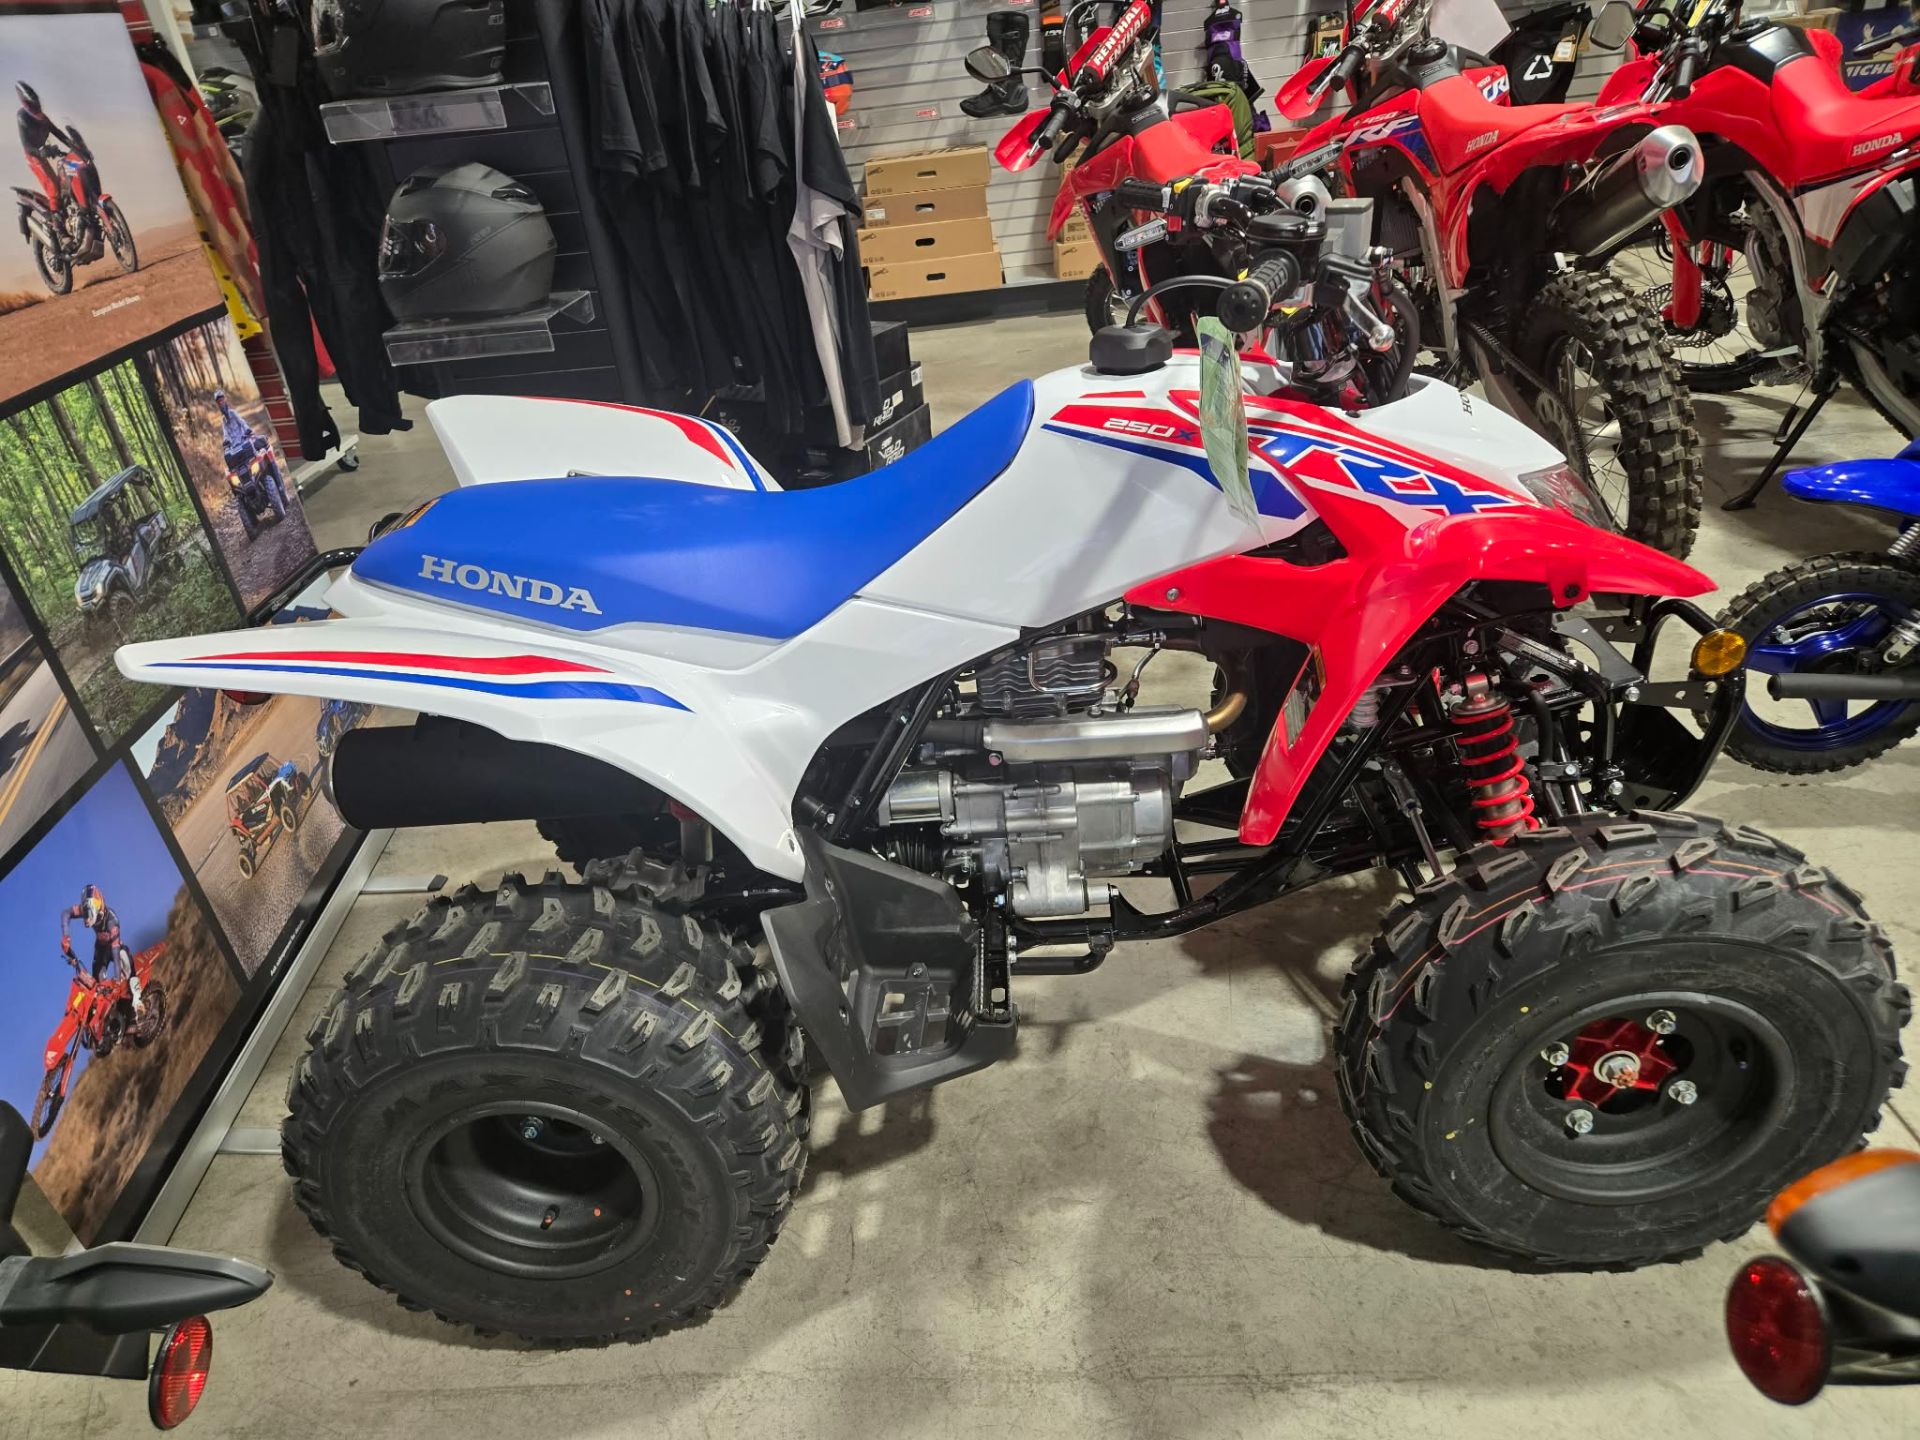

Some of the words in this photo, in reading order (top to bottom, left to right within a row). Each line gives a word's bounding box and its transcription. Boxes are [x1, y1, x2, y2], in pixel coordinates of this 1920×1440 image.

[1093, 6, 1142, 66] RENTHAL
[1465, 130, 1499, 153] HONDA
[1852, 132, 1902, 157] HONDA
[418, 555, 602, 615] HONDA
